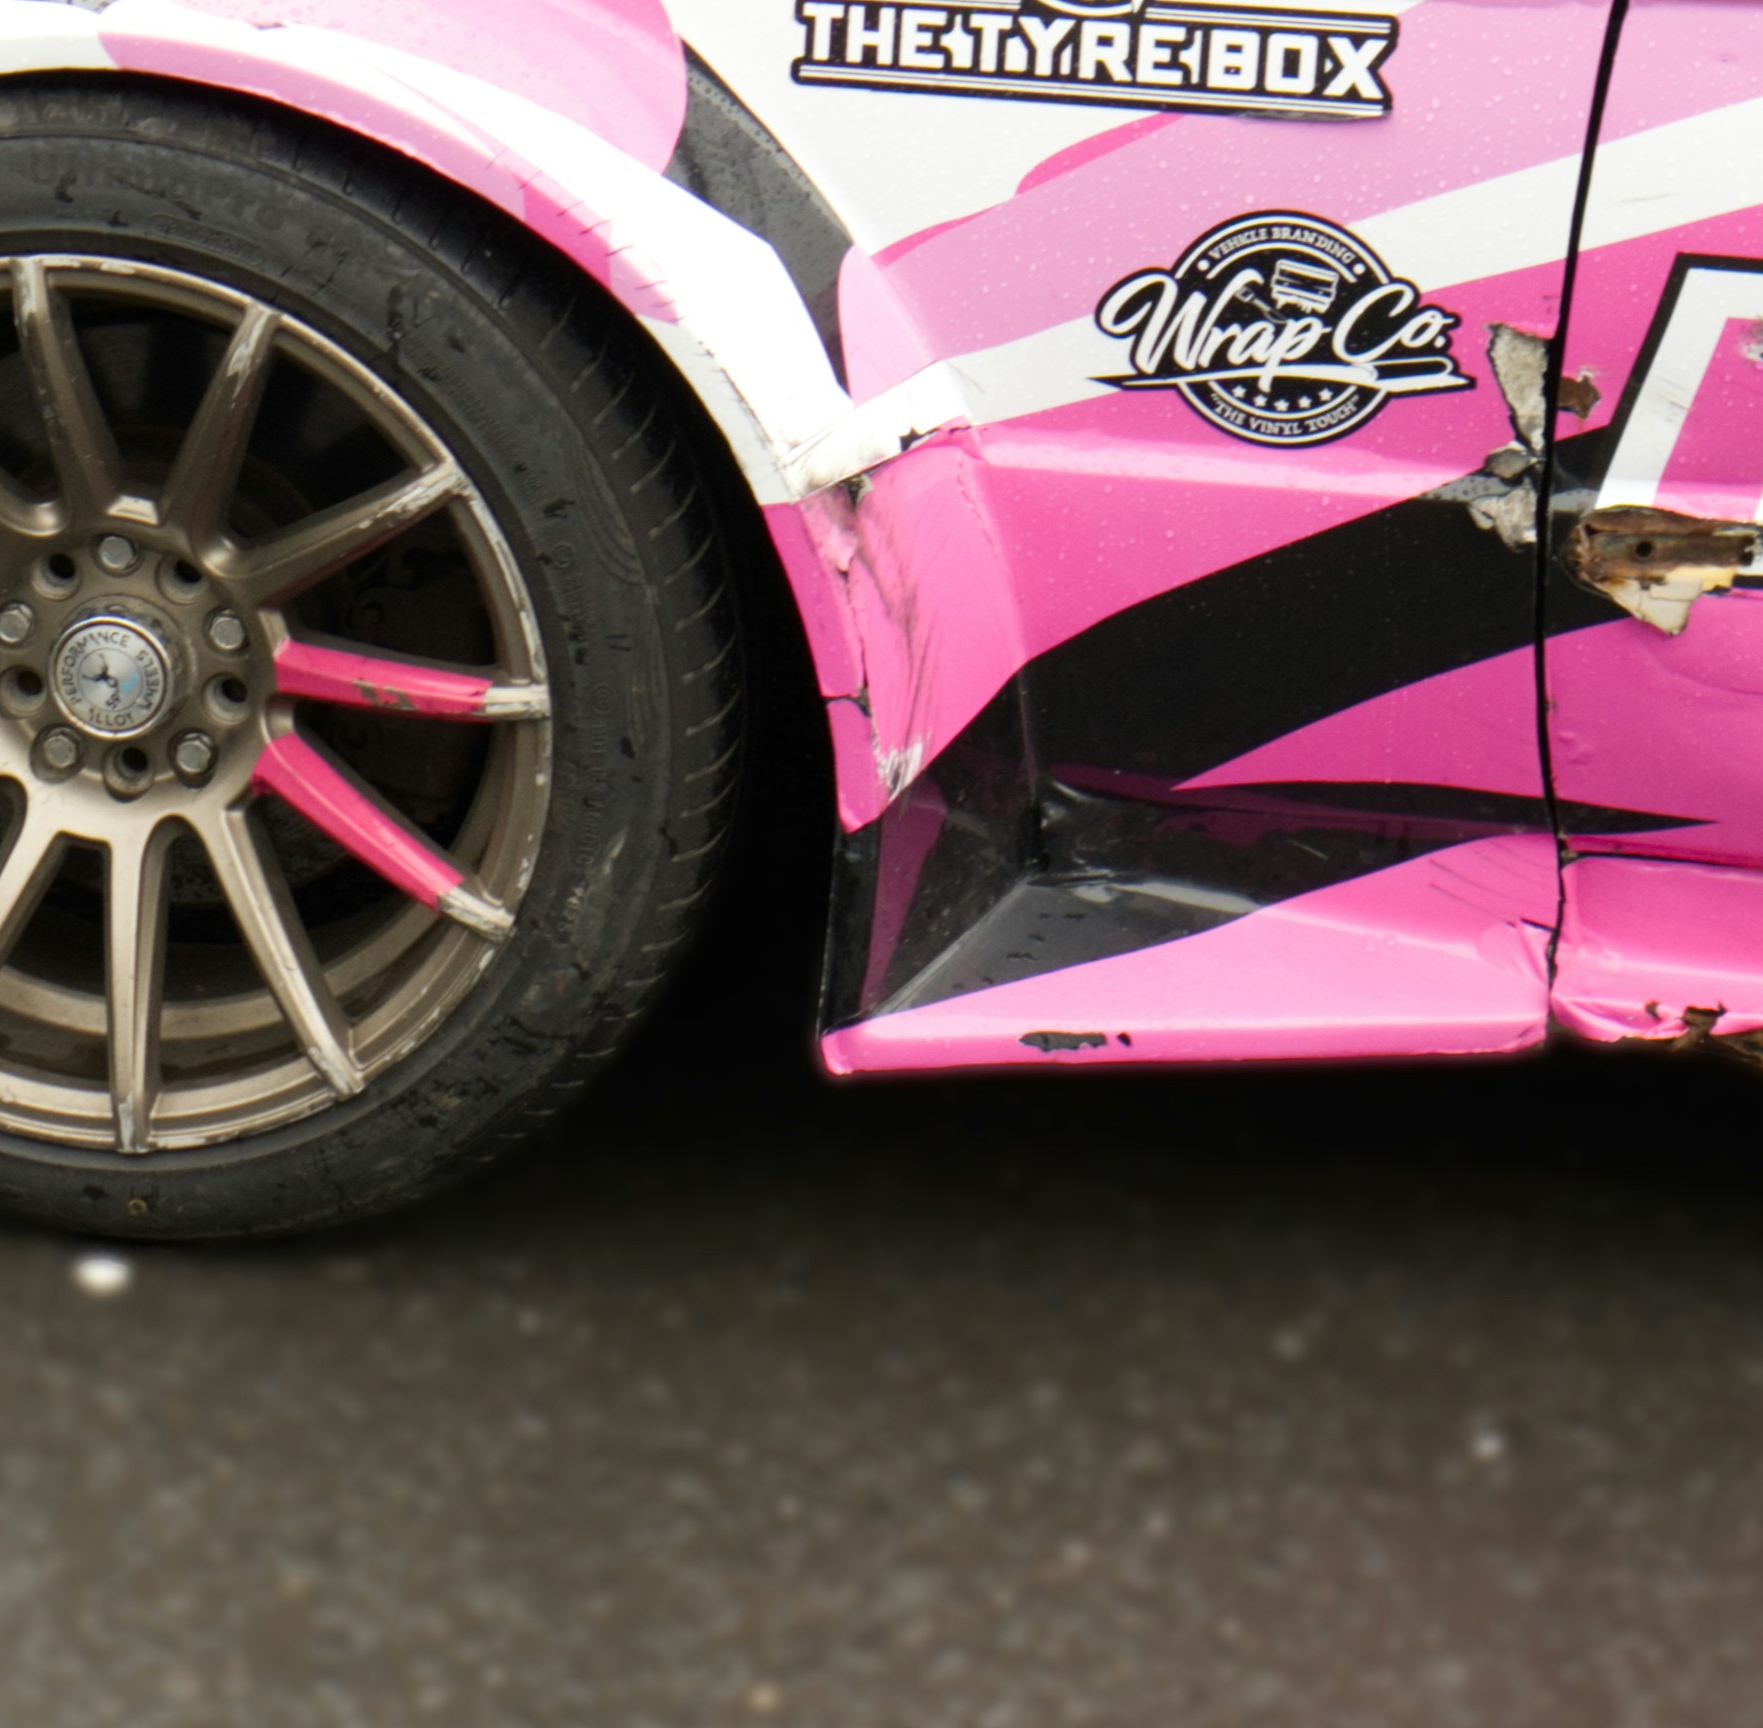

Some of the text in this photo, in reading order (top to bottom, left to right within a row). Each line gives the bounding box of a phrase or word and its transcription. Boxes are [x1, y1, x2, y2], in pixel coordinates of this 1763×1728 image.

[802, 2, 1387, 101] THE TYRE BOX
[1209, 226, 1356, 265] VEHICLE BRANDING
[1099, 268, 1456, 393] Wrap Co.
[1248, 418, 1303, 436] VINYL
[60, 629, 131, 705] PERFORMANCE
[88, 708, 135, 726] ALLOY
